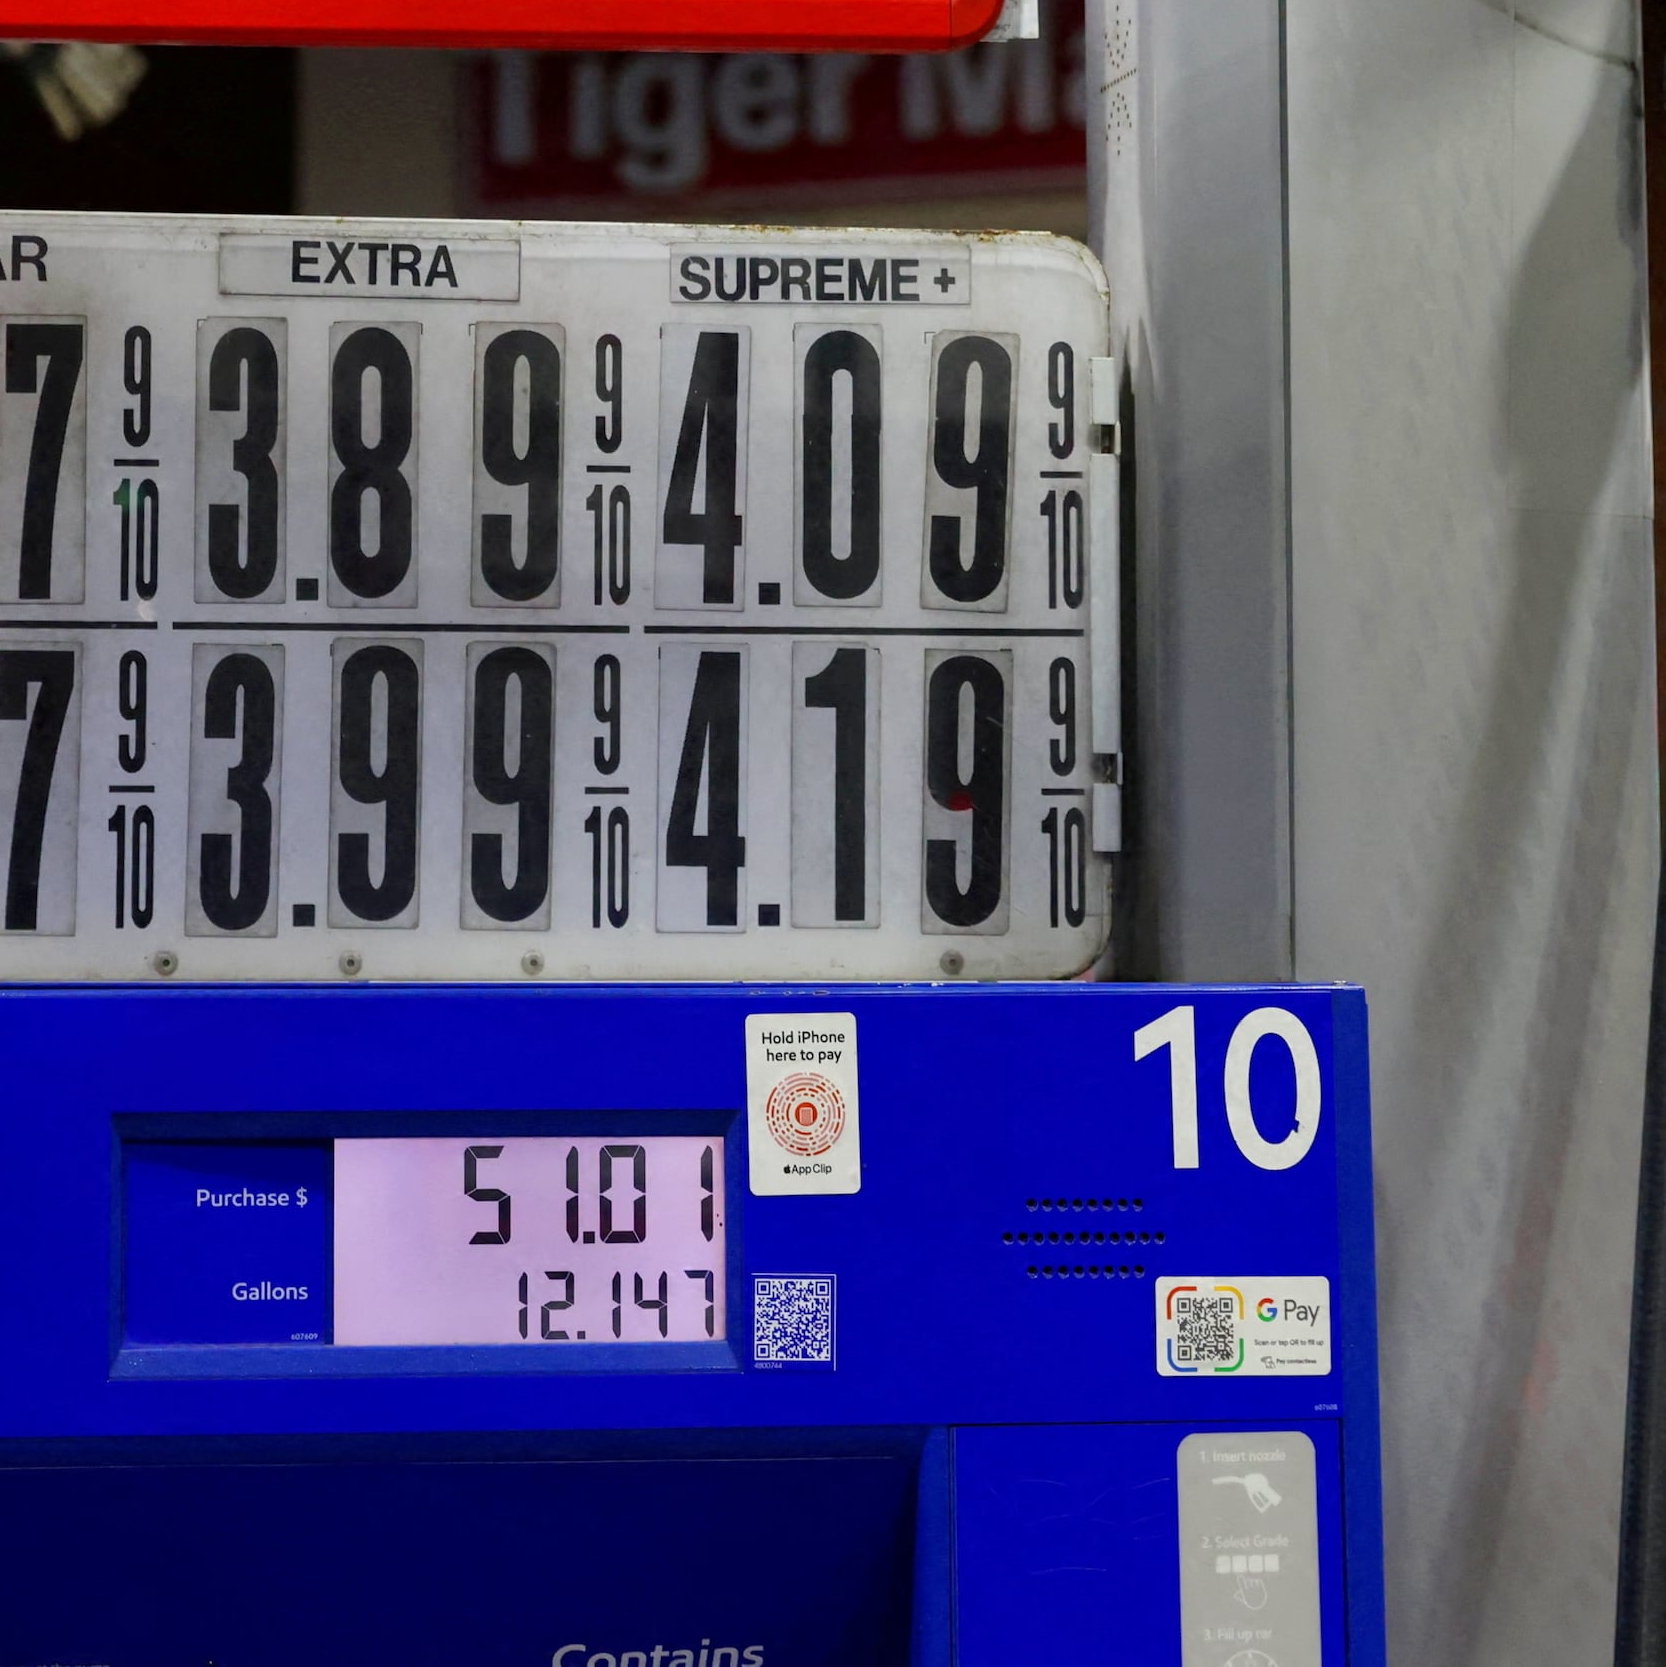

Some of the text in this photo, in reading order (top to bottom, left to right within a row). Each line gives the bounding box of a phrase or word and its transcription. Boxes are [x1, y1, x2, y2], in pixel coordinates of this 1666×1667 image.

[493, 50, 859, 193] Tiger
[292, 241, 458, 287] EXTRA
[206, 326, 562, 602] 3.89
[663, 330, 1010, 605] 4.09
[201, 643, 551, 930] 3.99
[666, 646, 1005, 928] 4.19
[762, 1031, 844, 1044] Hold iPhone
[767, 1049, 841, 1063] here to pay
[1134, 1005, 1321, 1170] 10
[792, 1164, 832, 1175] App Clip
[197, 1187, 307, 1207] Purchase $
[463, 1144, 713, 1245] 51.01
[233, 1282, 308, 1300] Gallons
[517, 1270, 716, 1341] 12.147
[1257, 1298, 1319, 1326] G Pay
[1199, 1451, 1285, 1462] 1. Insert nozzle
[1202, 1535, 1288, 1548] 2. Select Grade
